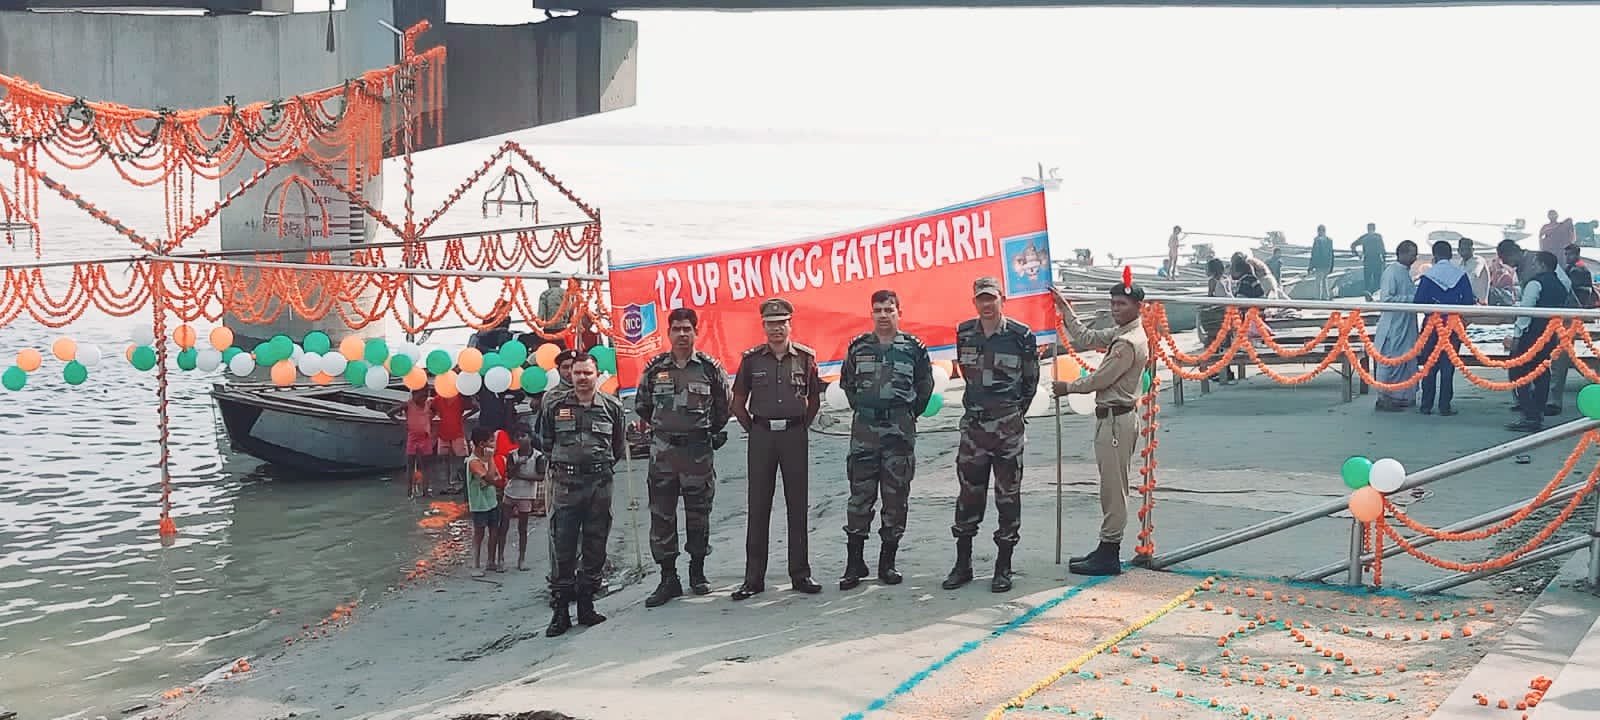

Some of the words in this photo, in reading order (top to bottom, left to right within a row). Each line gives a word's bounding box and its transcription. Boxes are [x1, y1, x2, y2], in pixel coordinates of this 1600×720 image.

[655, 267, 683, 312] 12
[687, 262, 720, 307] UP
[727, 255, 765, 301] BN
[769, 244, 824, 295] NCC
[830, 209, 995, 284] FATEHGARH
[625, 317, 641, 330] NCC
